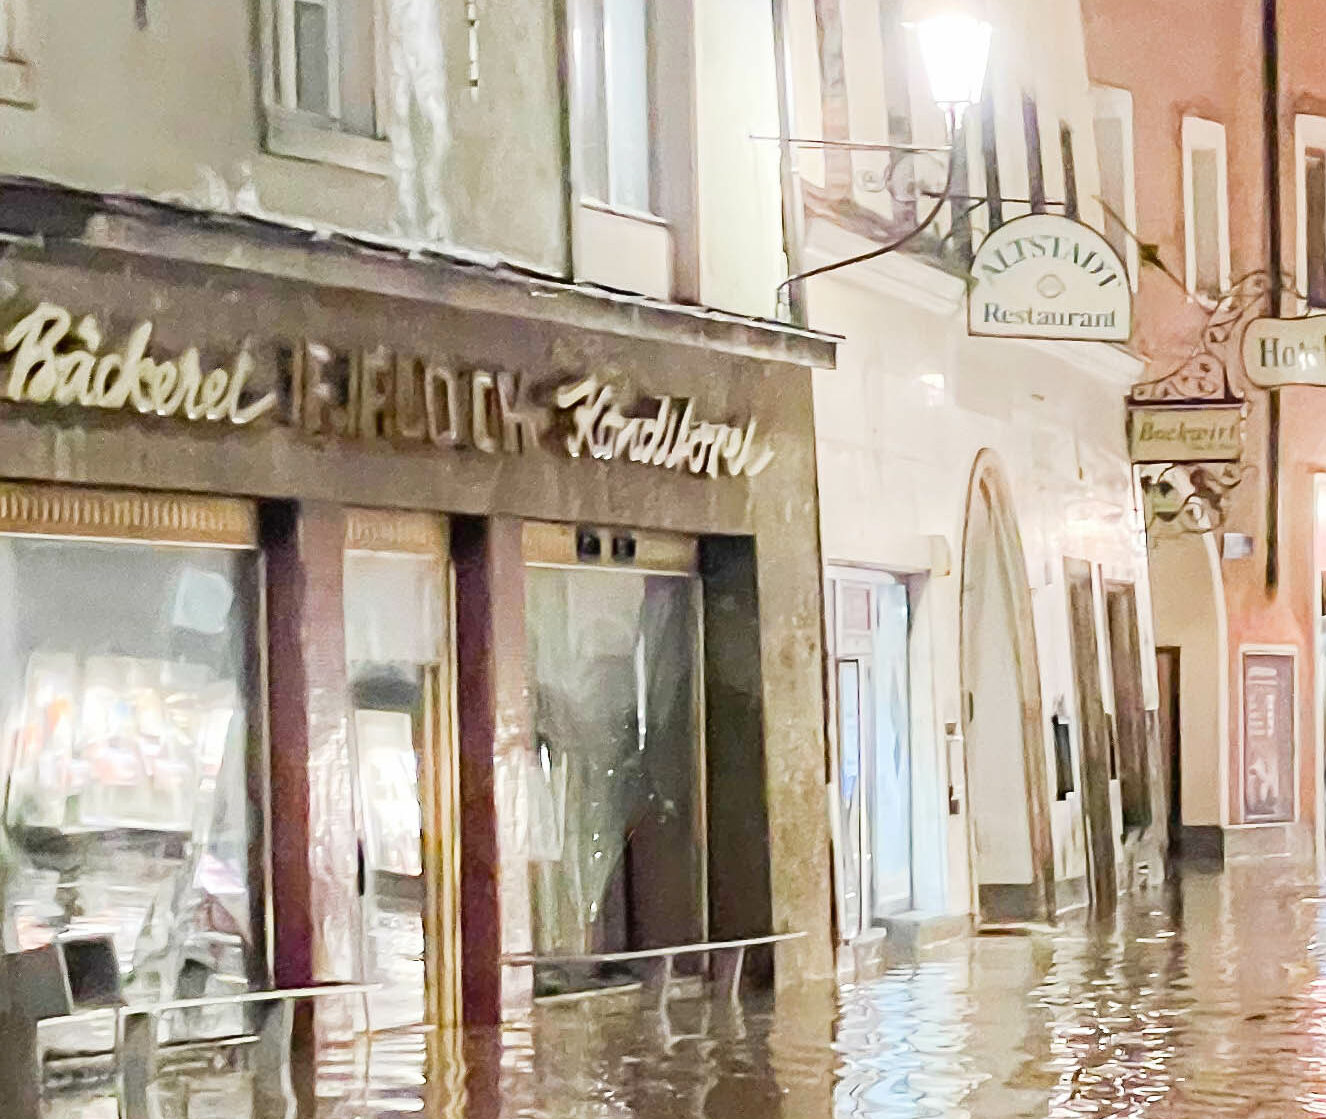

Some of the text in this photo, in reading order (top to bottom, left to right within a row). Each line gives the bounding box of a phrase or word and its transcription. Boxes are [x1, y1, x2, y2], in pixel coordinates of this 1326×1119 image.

[981, 234, 1122, 287] ALTSTADT
[983, 301, 1117, 328] Restaurant
[4, 301, 277, 423] Bäckerei
